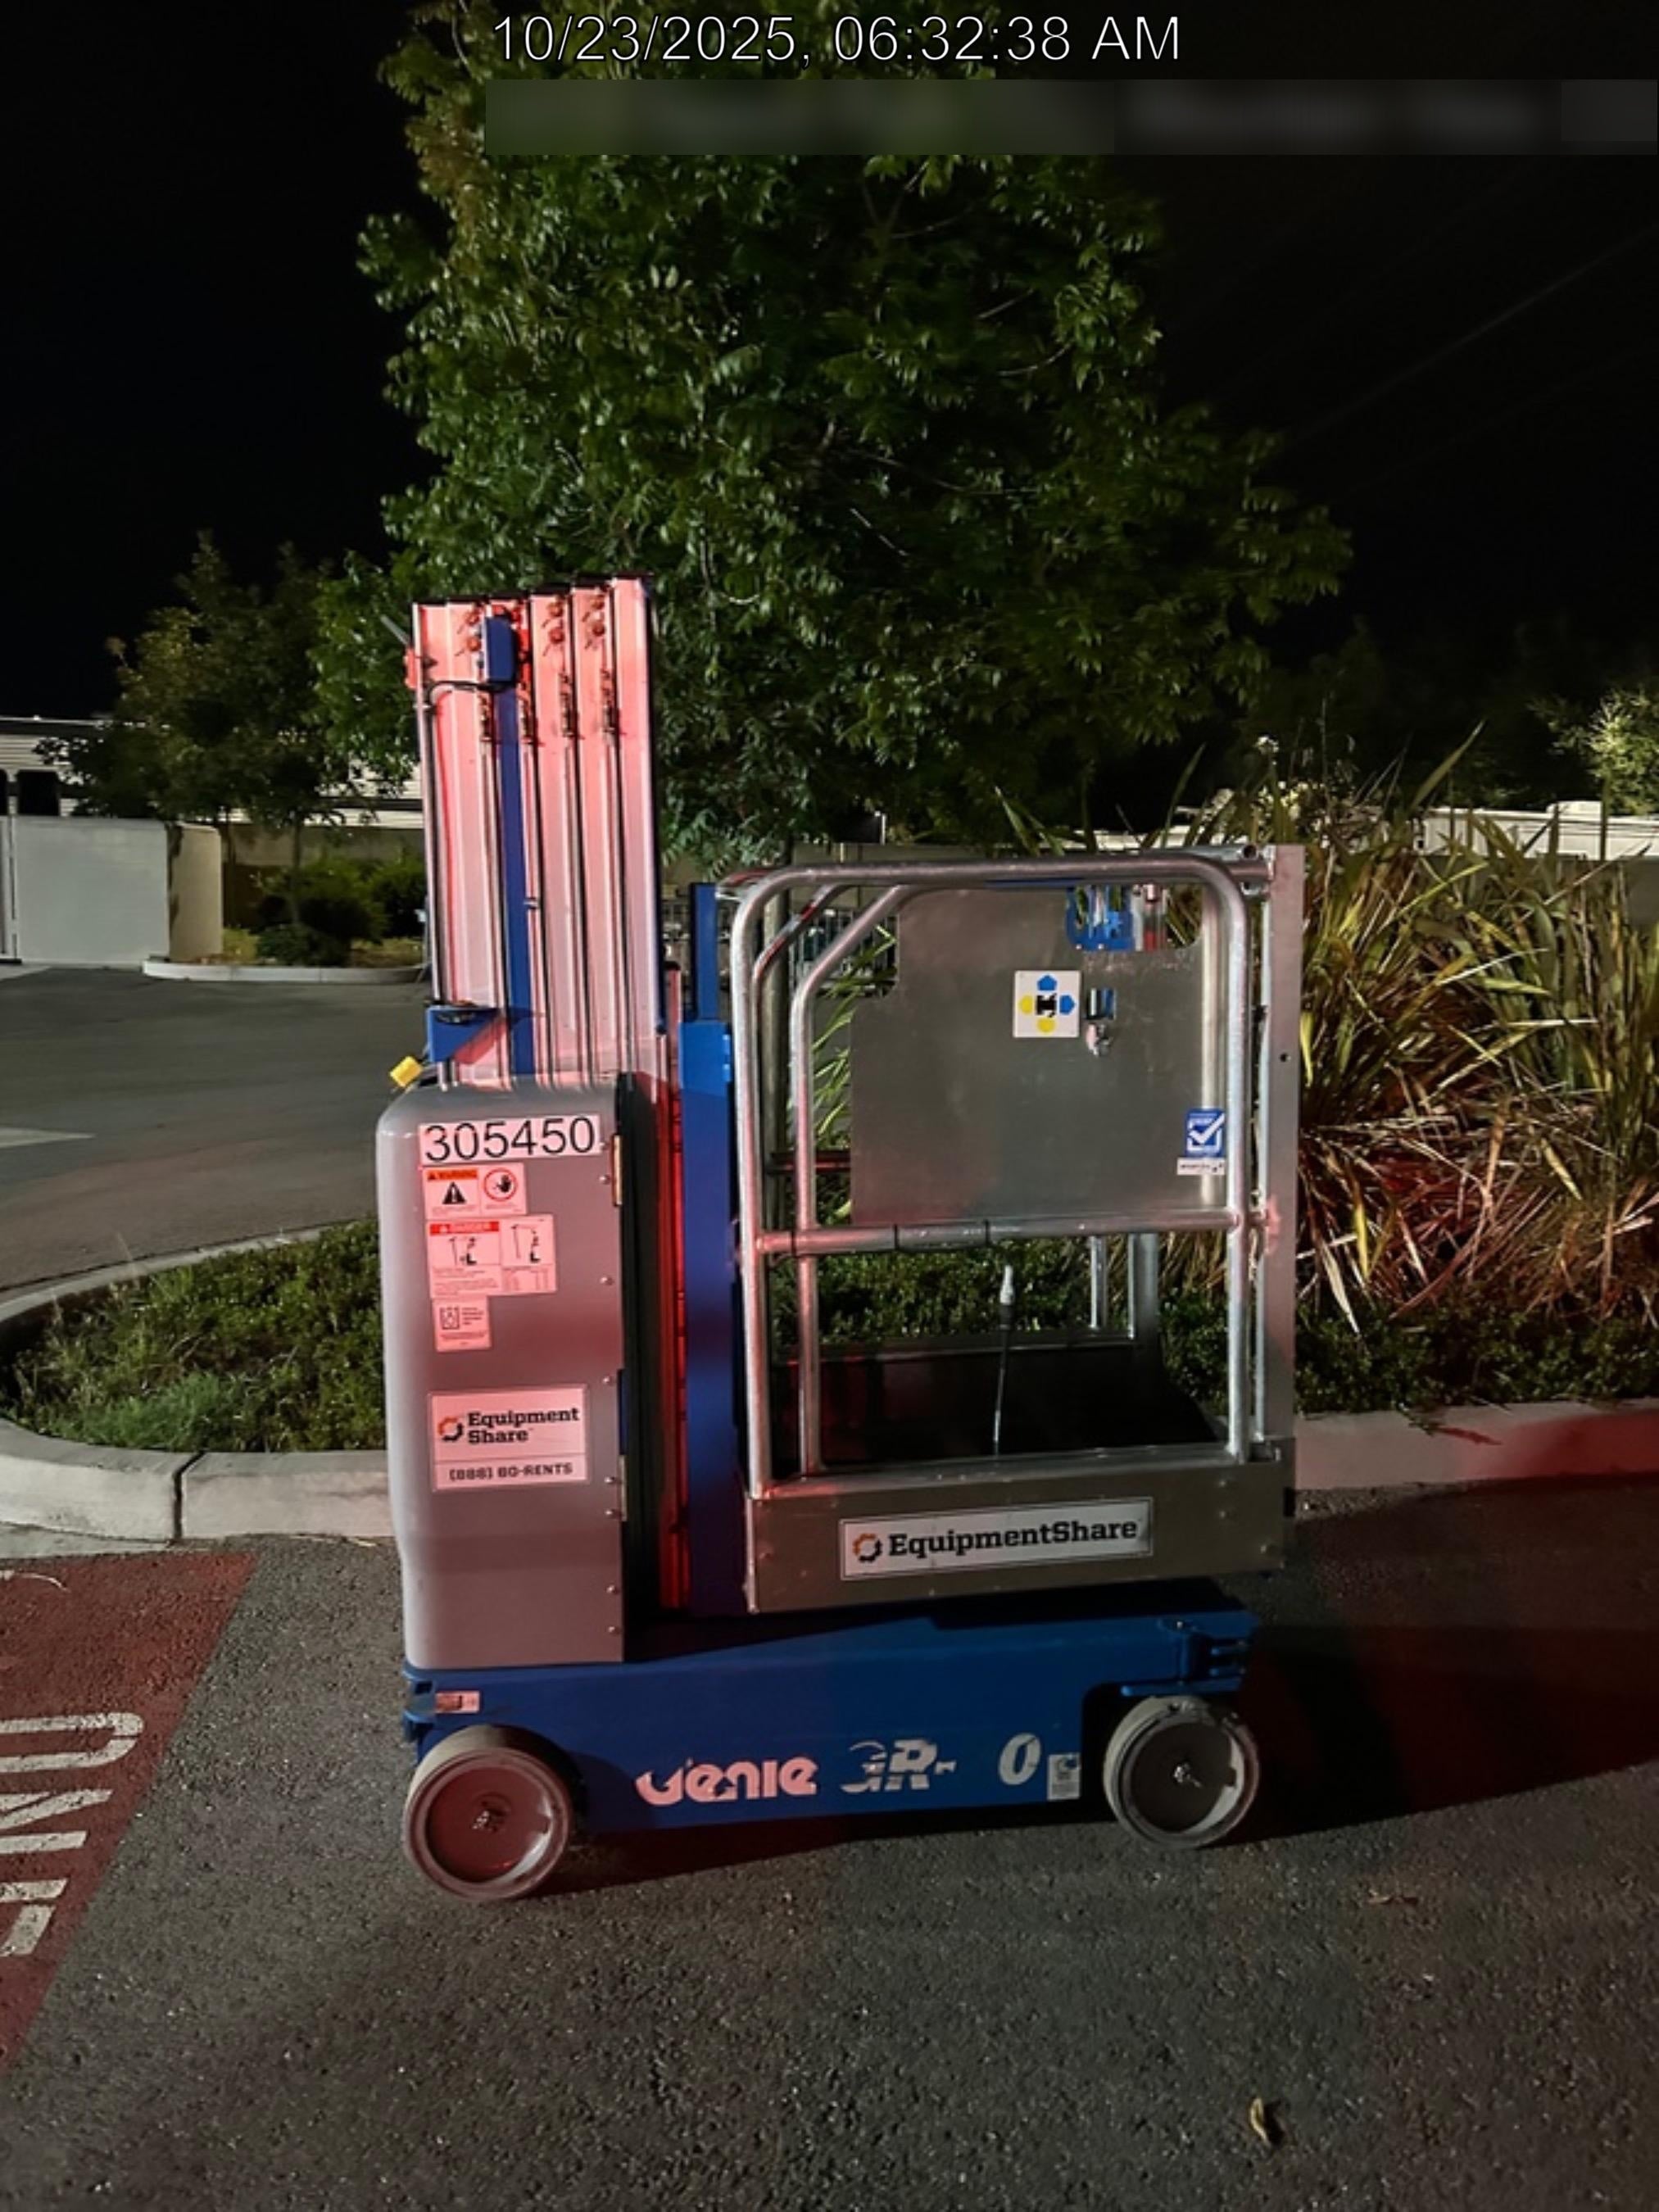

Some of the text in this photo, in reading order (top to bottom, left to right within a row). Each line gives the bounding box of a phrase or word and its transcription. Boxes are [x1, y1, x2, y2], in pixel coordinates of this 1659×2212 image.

[425, 1117, 594, 1162] 305450
[467, 1408, 580, 1429] Equipment
[468, 1429, 529, 1444] Share
[888, 1521, 1138, 1559] EquipmentShare
